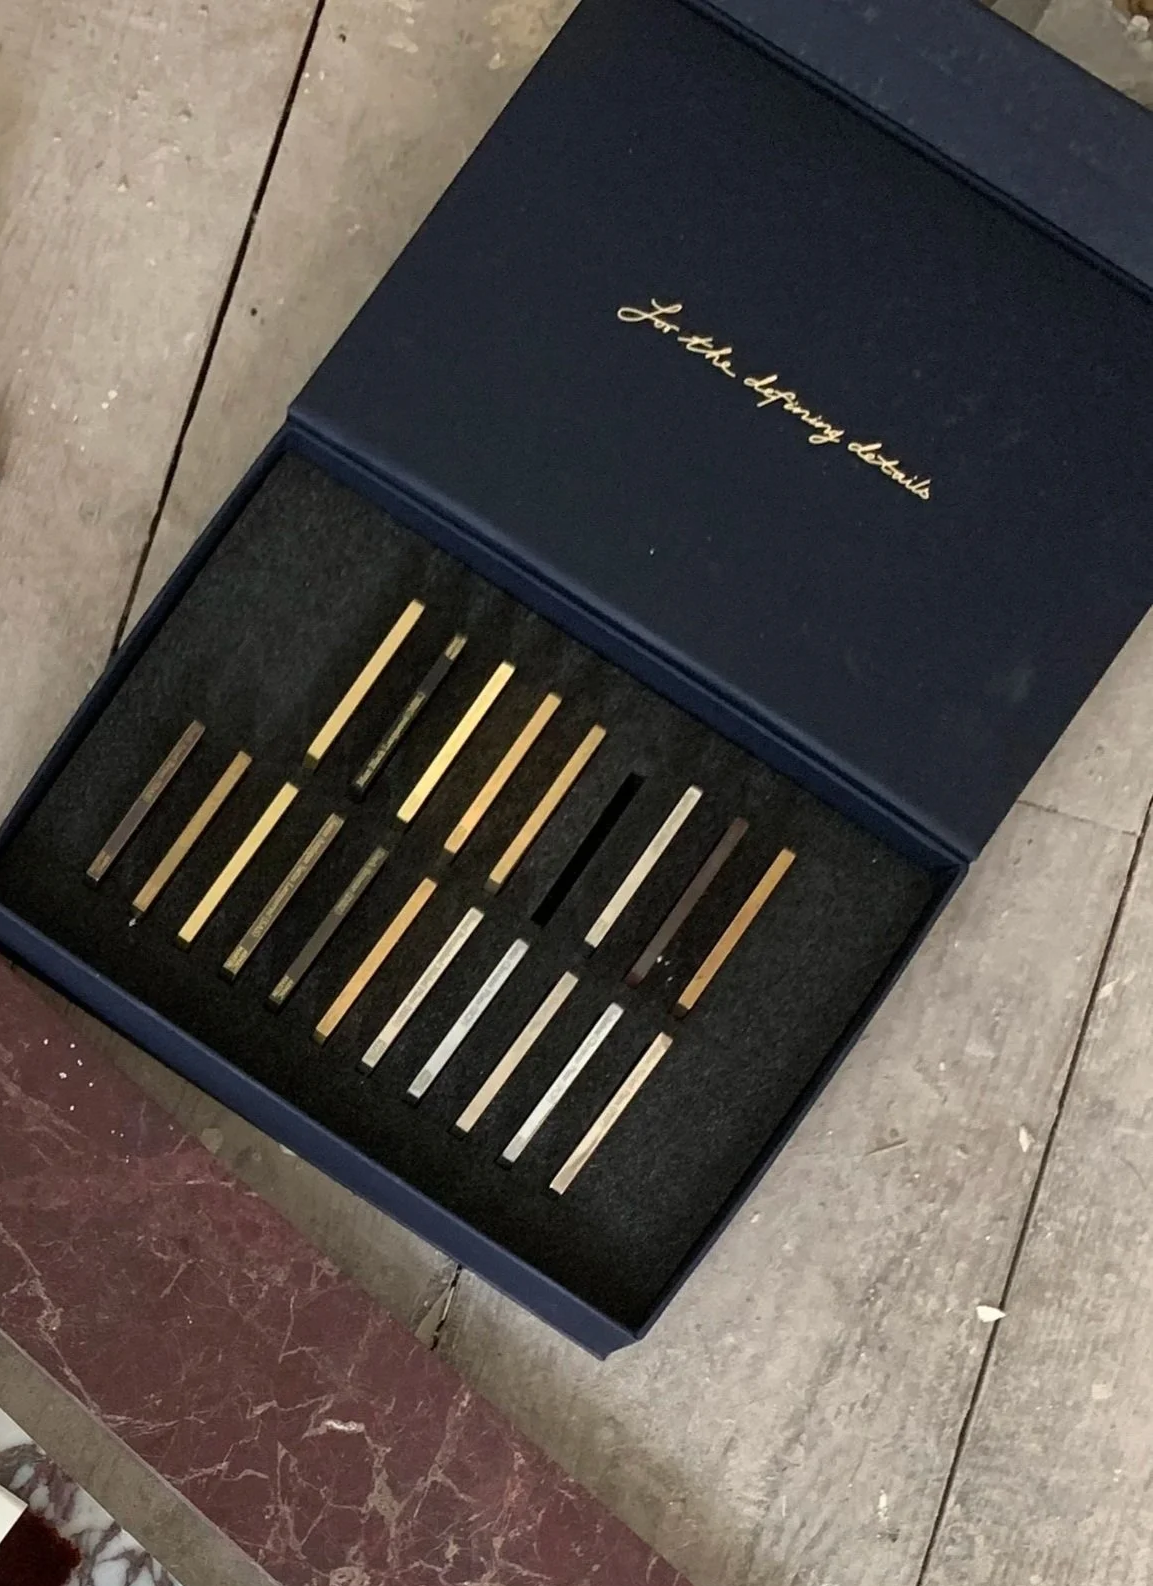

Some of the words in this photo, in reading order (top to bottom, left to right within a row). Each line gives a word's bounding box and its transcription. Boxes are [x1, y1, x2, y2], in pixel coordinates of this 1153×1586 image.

[617, 299, 682, 333] For
[678, 336, 736, 377] the
[744, 374, 844, 444] defining
[848, 442, 930, 499] details
